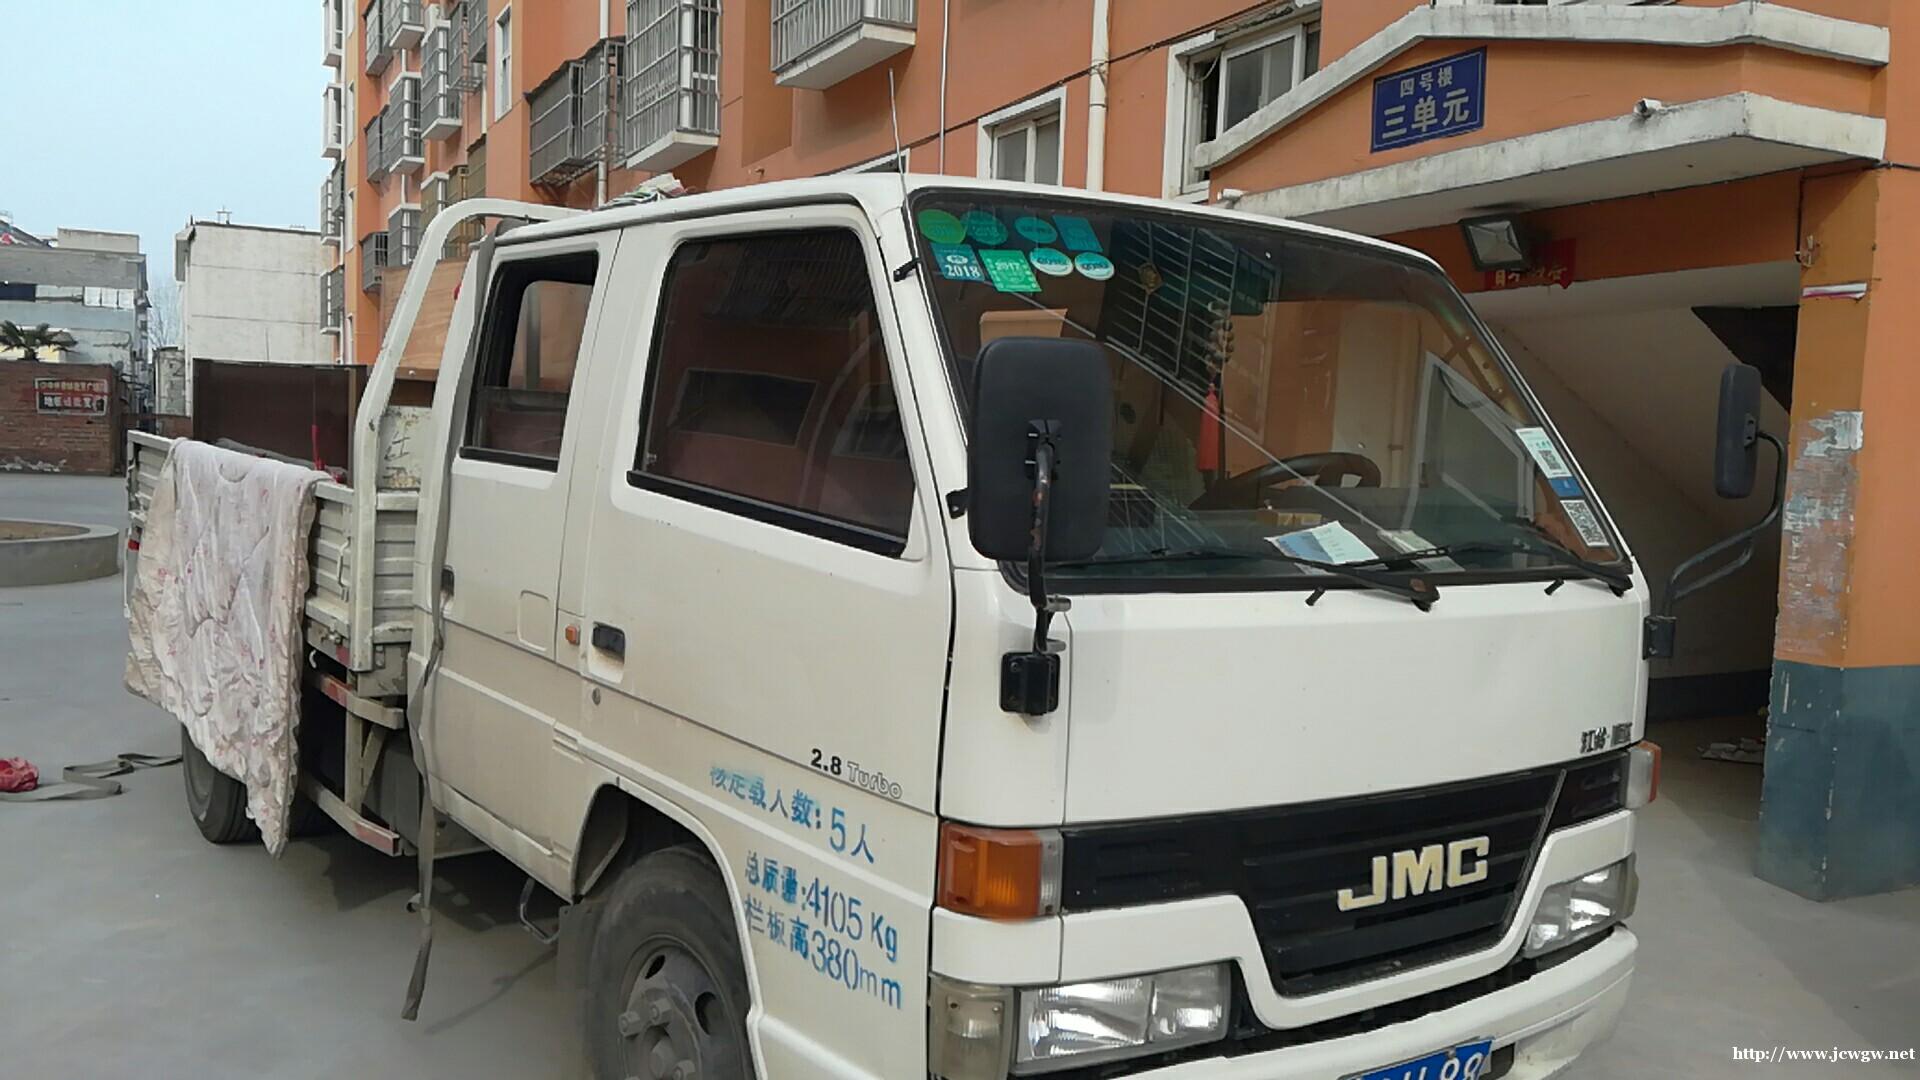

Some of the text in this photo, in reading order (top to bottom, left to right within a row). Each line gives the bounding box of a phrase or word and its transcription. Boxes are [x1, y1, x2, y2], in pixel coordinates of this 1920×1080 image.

[1399, 65, 1453, 98] 四号楼
[1382, 88, 1469, 139] 三单元
[944, 264, 980, 278] 2018
[811, 748, 902, 800] 2.8 Turbo
[1337, 835, 1490, 912] JMC
